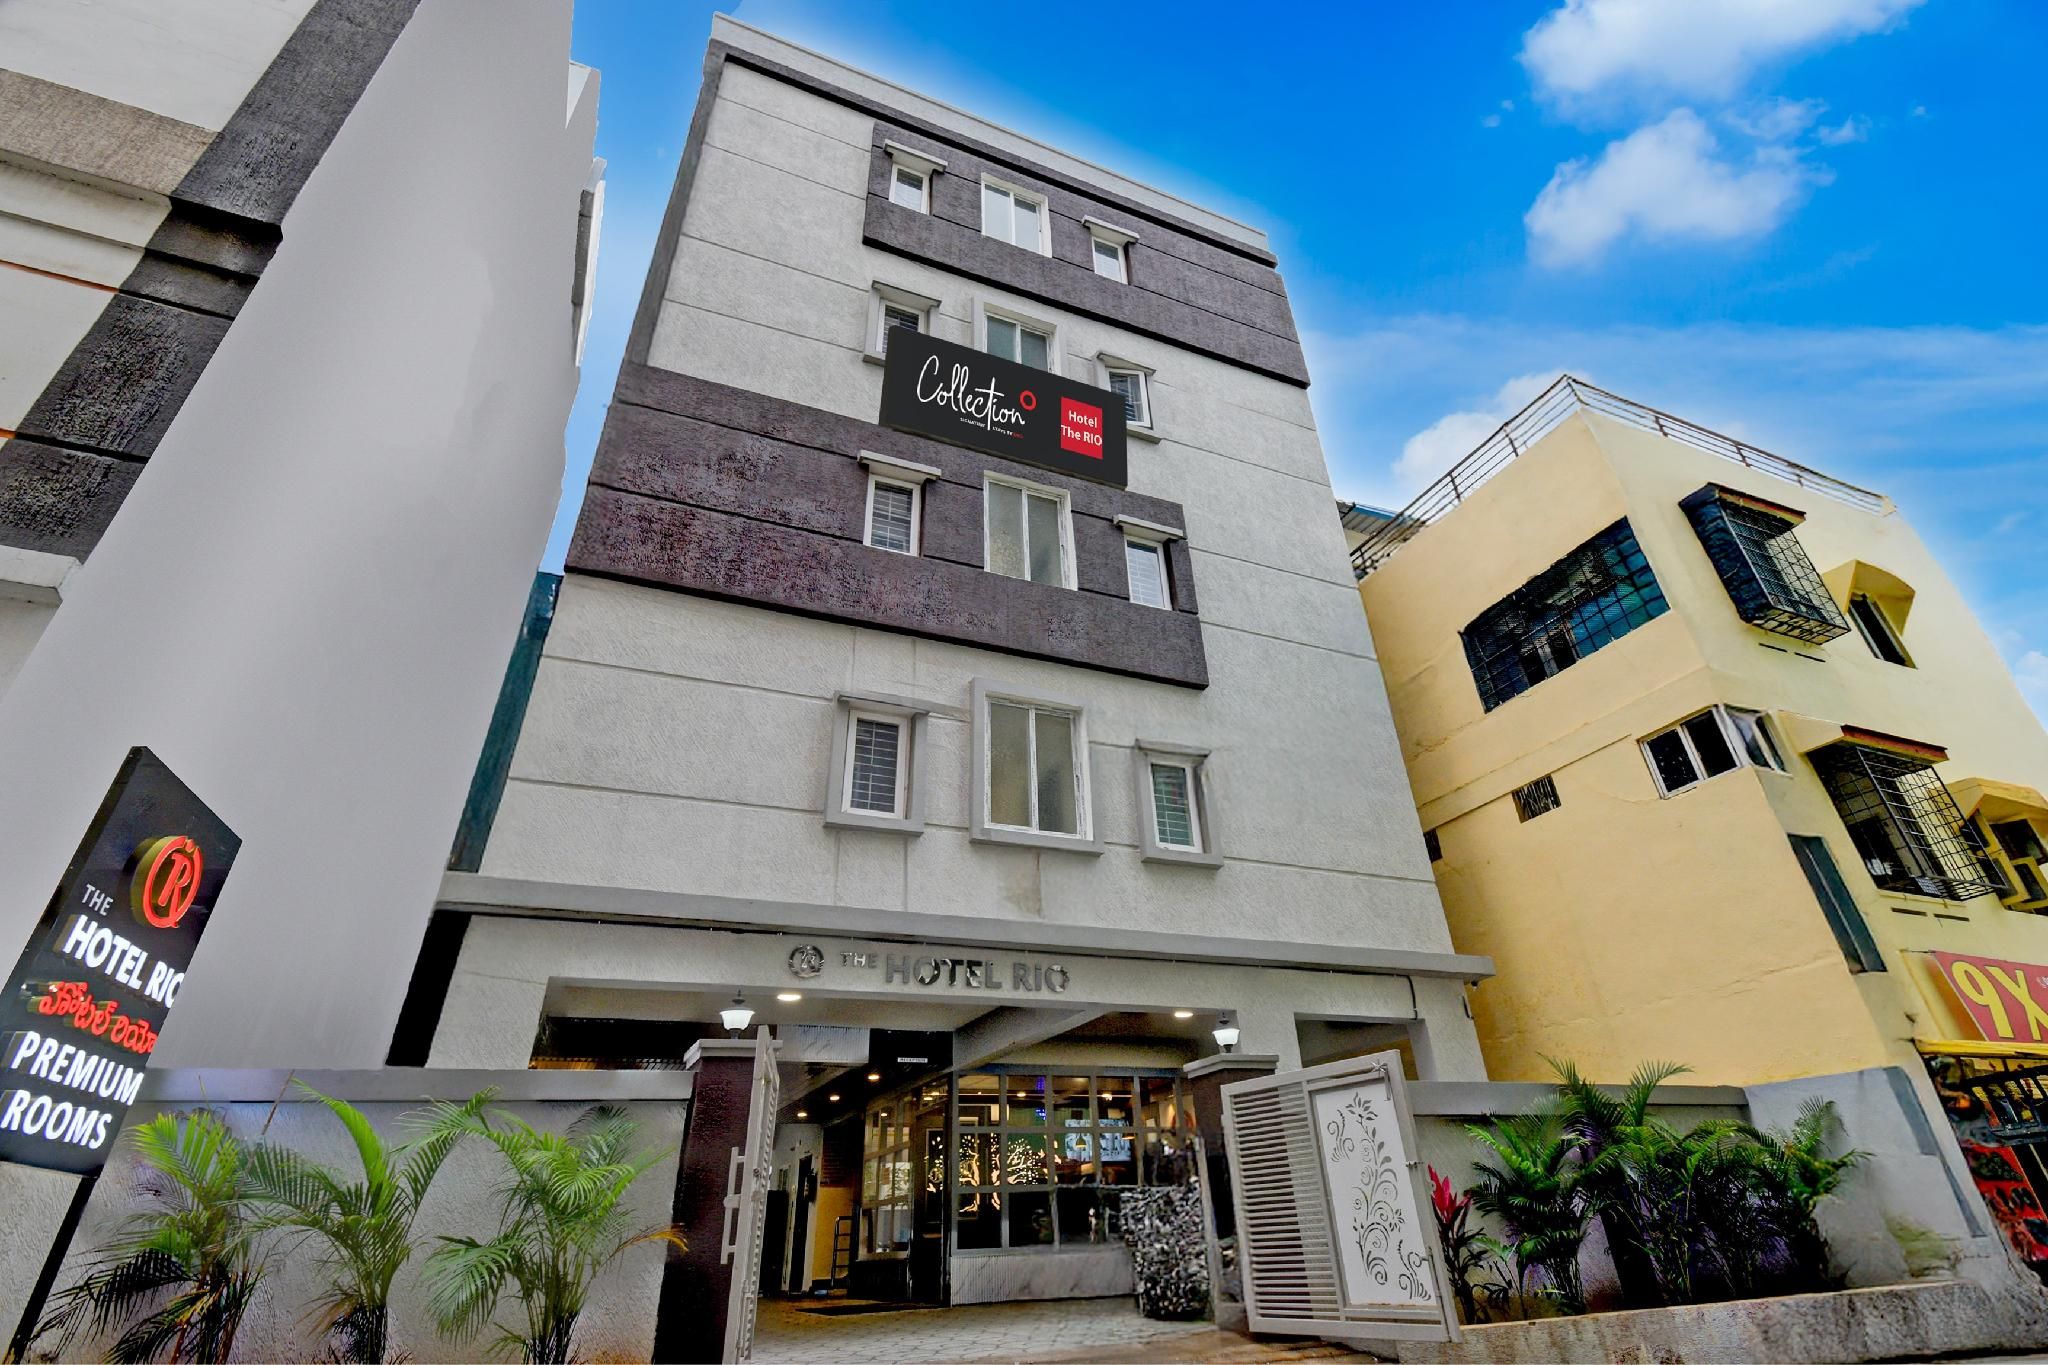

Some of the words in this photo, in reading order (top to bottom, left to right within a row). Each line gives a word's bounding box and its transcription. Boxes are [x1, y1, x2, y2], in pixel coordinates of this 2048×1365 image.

[917, 354, 1026, 431] Collection
[1060, 424, 1081, 441] The
[1083, 430, 1103, 447] RIO
[1067, 409, 1098, 429] Hotel
[81, 883, 114, 917] THE
[62, 913, 149, 991] HOTEL
[839, 951, 878, 970] THE
[885, 952, 1002, 989] HOTEL
[1011, 962, 1070, 993] RIO
[10, 1030, 145, 1107] PREMIUM
[0, 1089, 113, 1150] ROOMS
